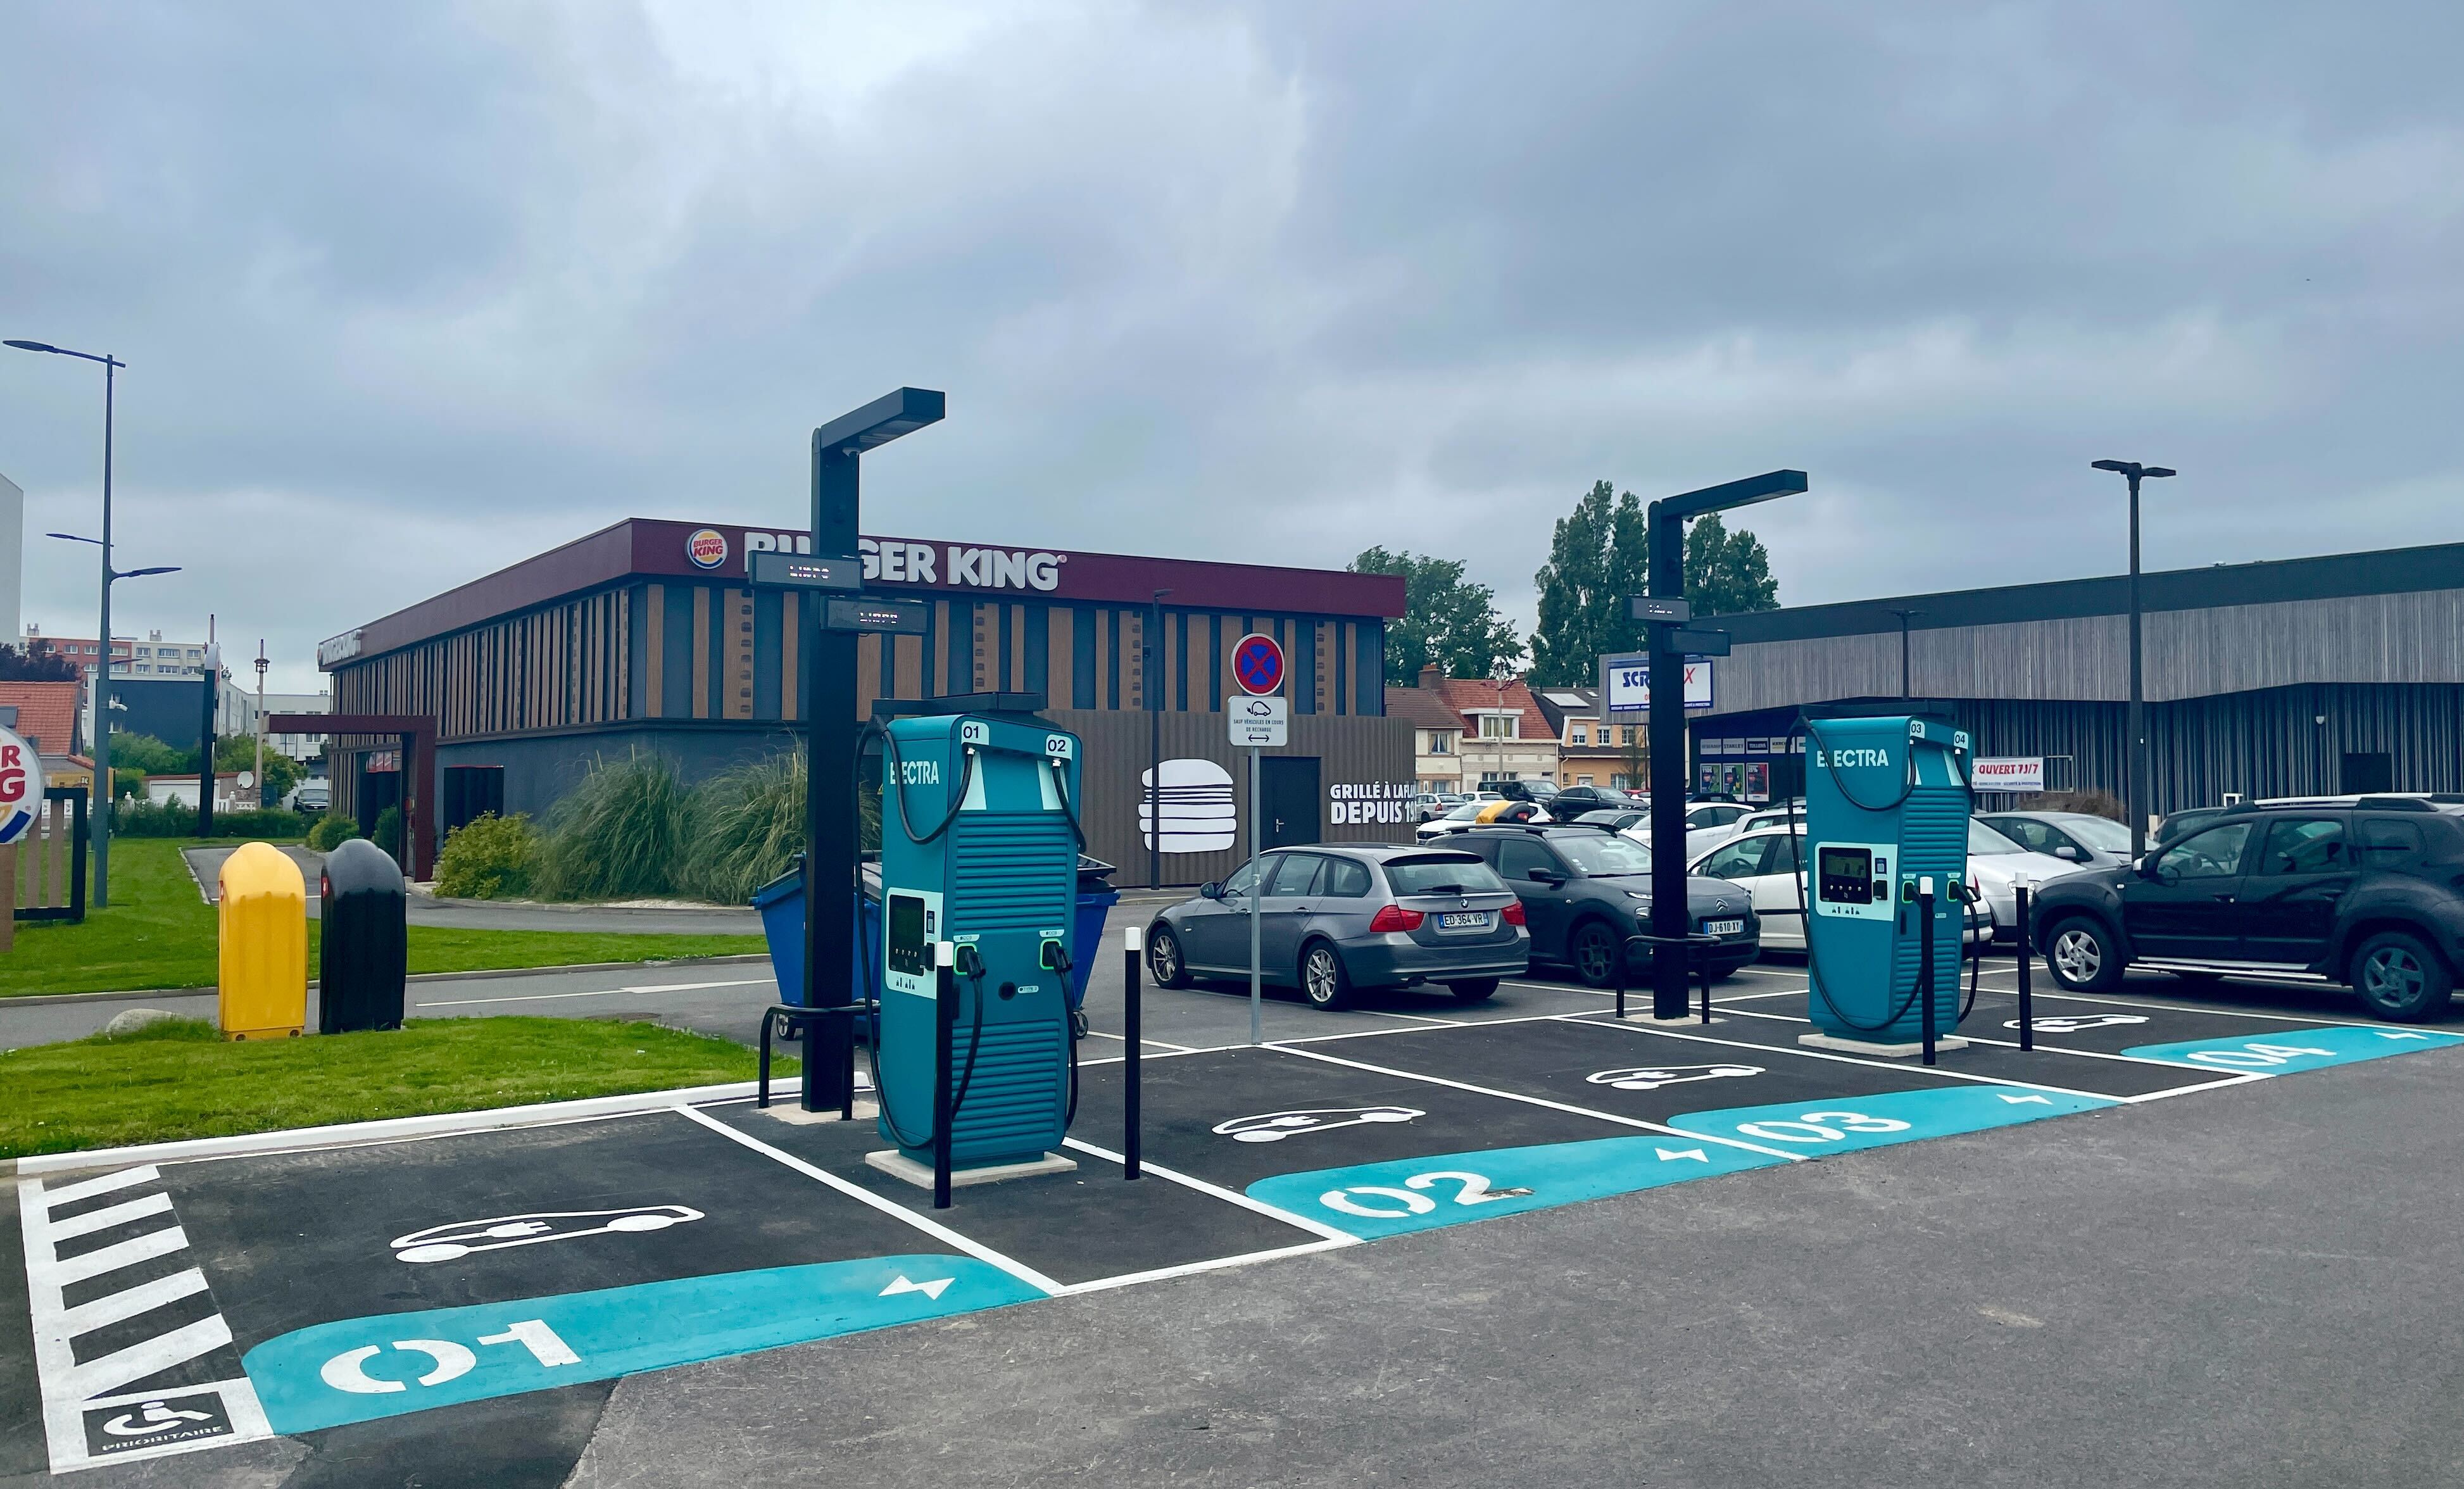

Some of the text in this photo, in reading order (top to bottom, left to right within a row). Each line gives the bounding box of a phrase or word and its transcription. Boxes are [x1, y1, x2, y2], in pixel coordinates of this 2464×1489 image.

[693, 539, 723, 548] BURGER
[694, 546, 723, 557] KING
[744, 532, 937, 584] BGER
[963, 726, 980, 739] 01
[1911, 724, 1921, 733] 03
[1048, 739, 1066, 752] 02
[1955, 734, 1966, 744] 04
[1817, 749, 1889, 767] EECTRA
[890, 760, 940, 784] EECTRA
[1979, 764, 2015, 774] OUVERT
[1329, 781, 1380, 799] GRILLÉ
[1383, 781, 1391, 798] À
[1393, 784, 1404, 798] LA
[1331, 801, 1416, 824] DEPUIS 19
[2187, 1043, 2337, 1066] 04
[1736, 1112, 1911, 1142] 03
[1319, 1171, 1535, 1218] 02
[320, 1319, 582, 1394] 01
[101, 1426, 223, 1451] PRIORITAIRE
